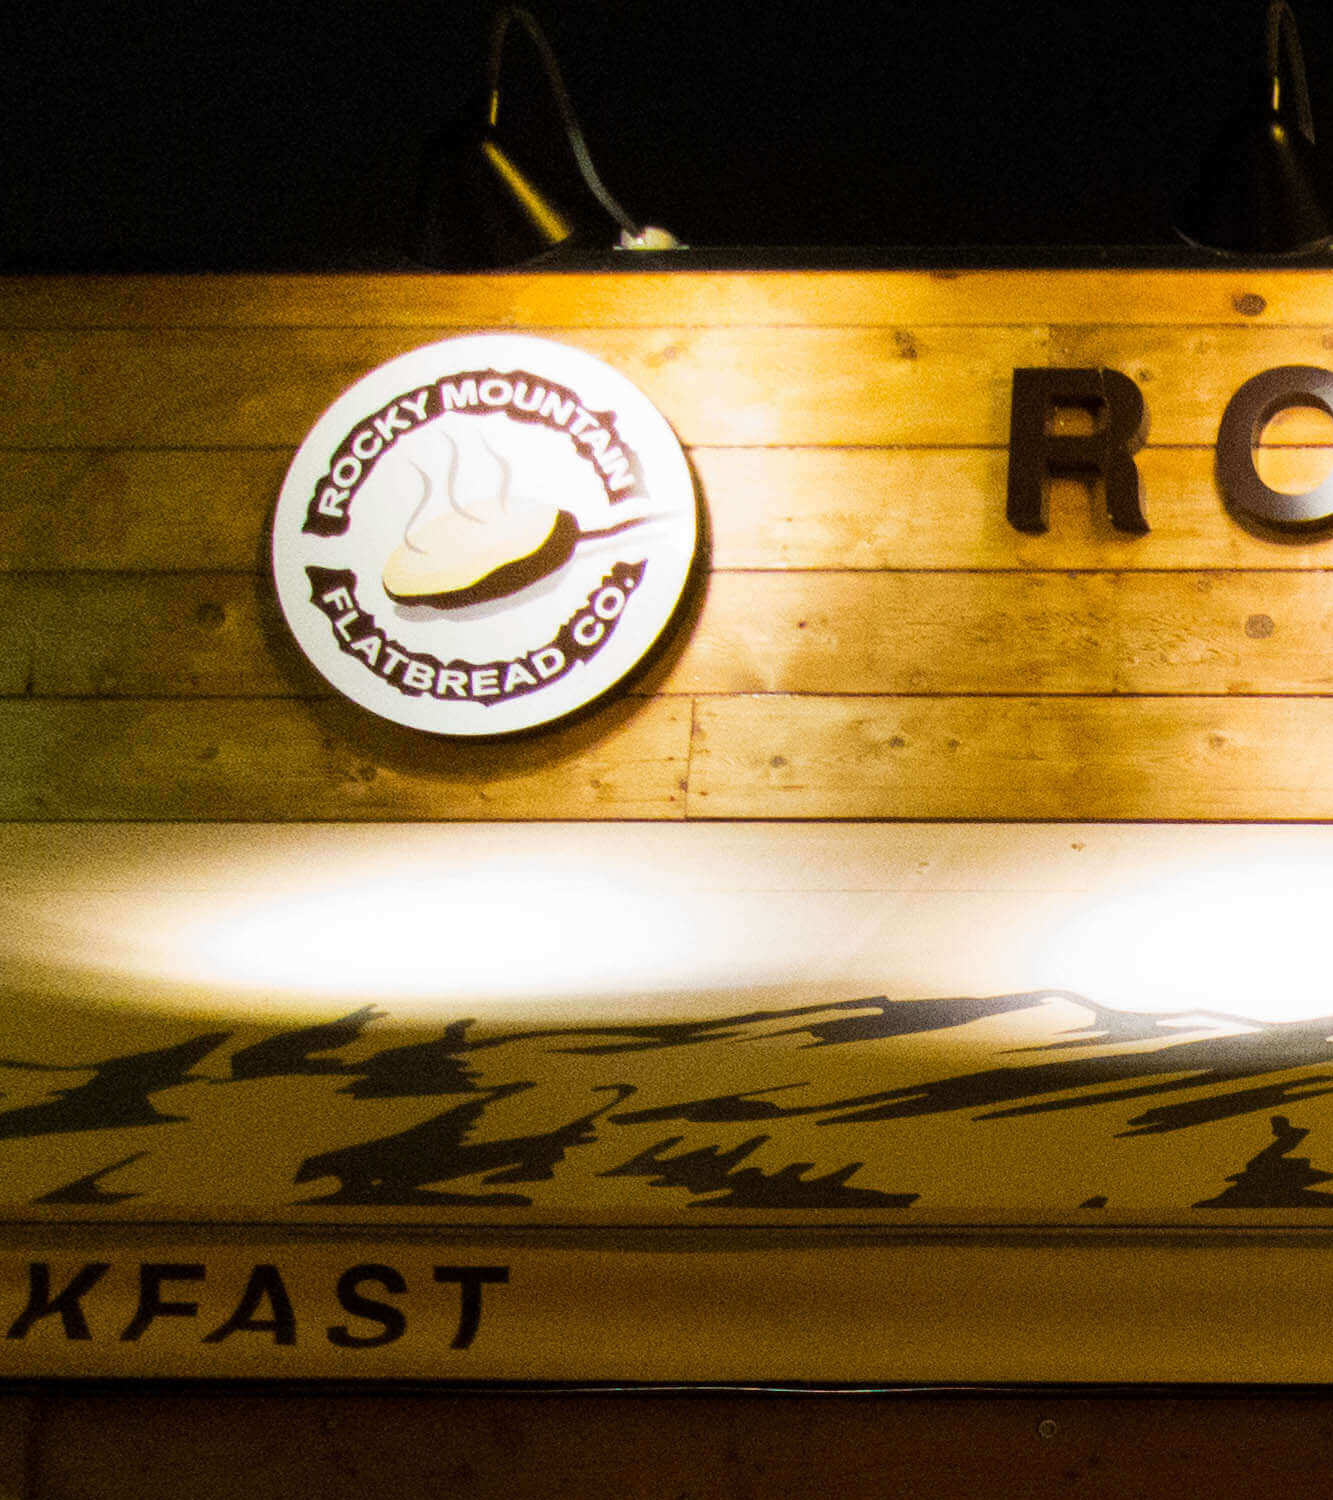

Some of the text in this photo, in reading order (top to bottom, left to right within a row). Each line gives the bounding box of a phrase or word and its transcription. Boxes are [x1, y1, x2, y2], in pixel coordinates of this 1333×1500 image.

[318, 377, 637, 518] ROCKY MOUNTAIN
[321, 577, 635, 697] FLATBREAD CO.
